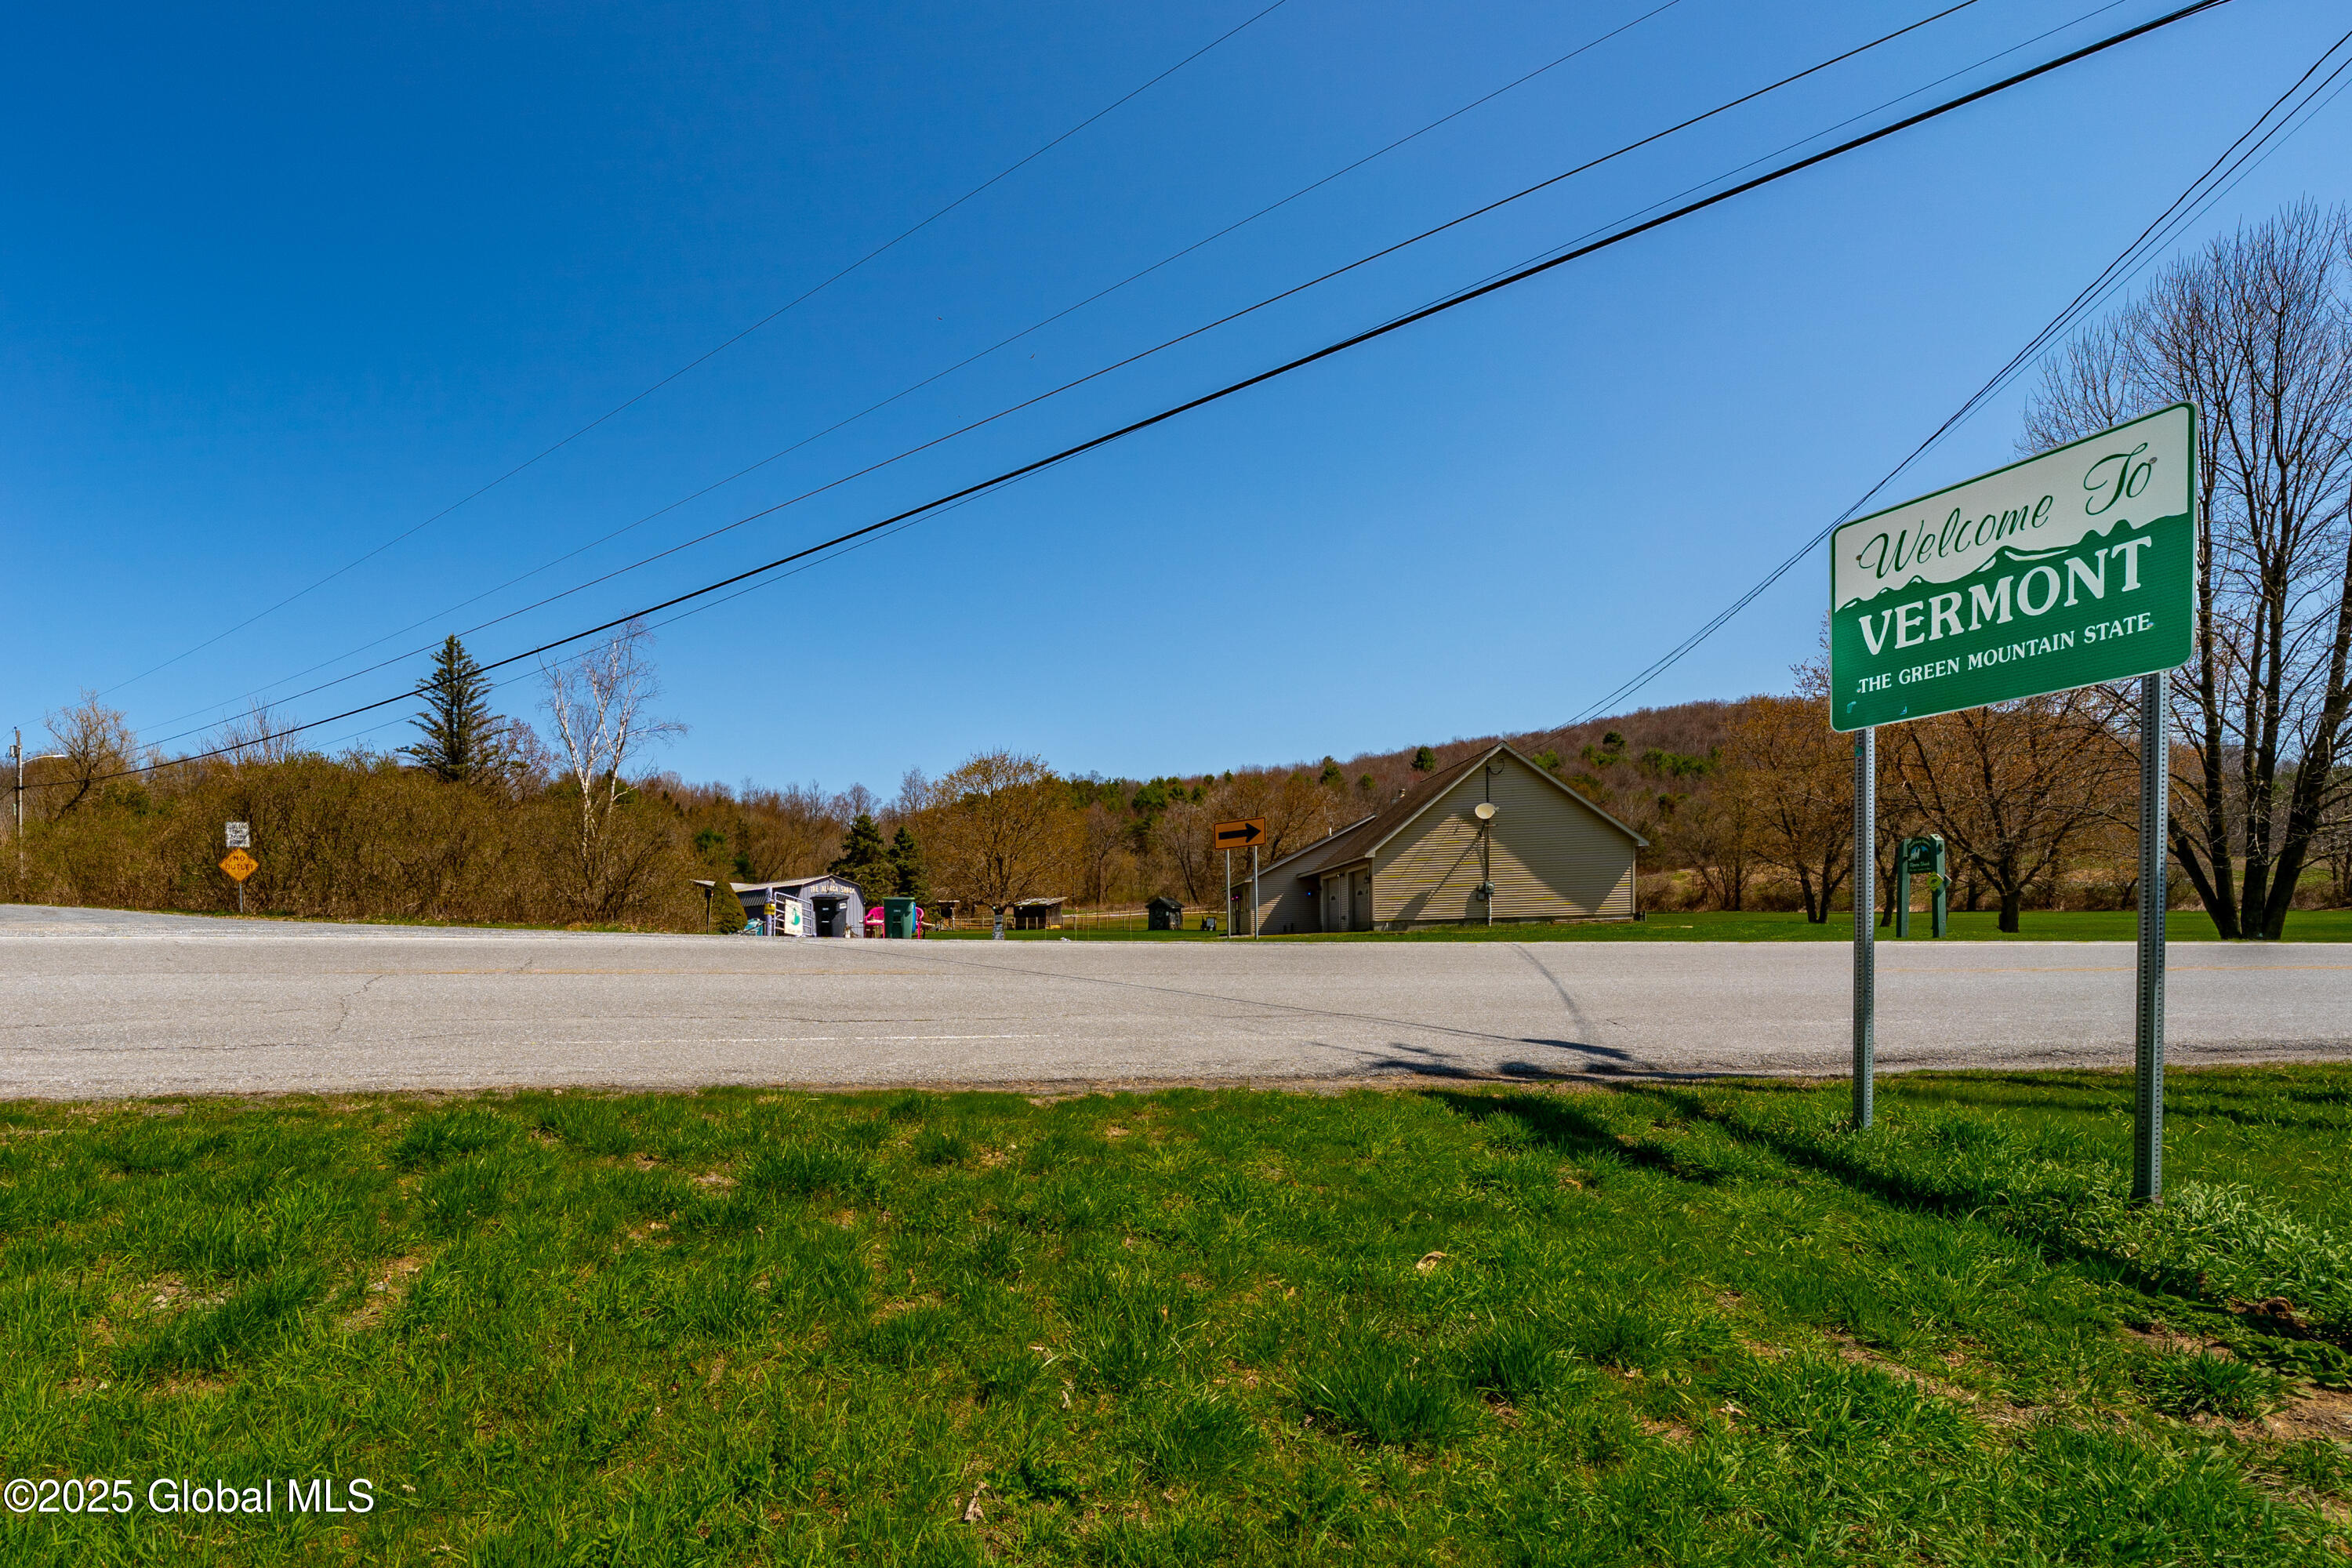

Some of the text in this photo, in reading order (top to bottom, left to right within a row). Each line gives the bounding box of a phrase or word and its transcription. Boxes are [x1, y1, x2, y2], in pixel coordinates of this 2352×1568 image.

[1858, 442, 2153, 579] Welcome To
[1858, 535, 2153, 656] VERMONT
[1859, 612, 2152, 694] THE GREEN MOUNTAIN STATE
[810, 885, 819, 894] THE
